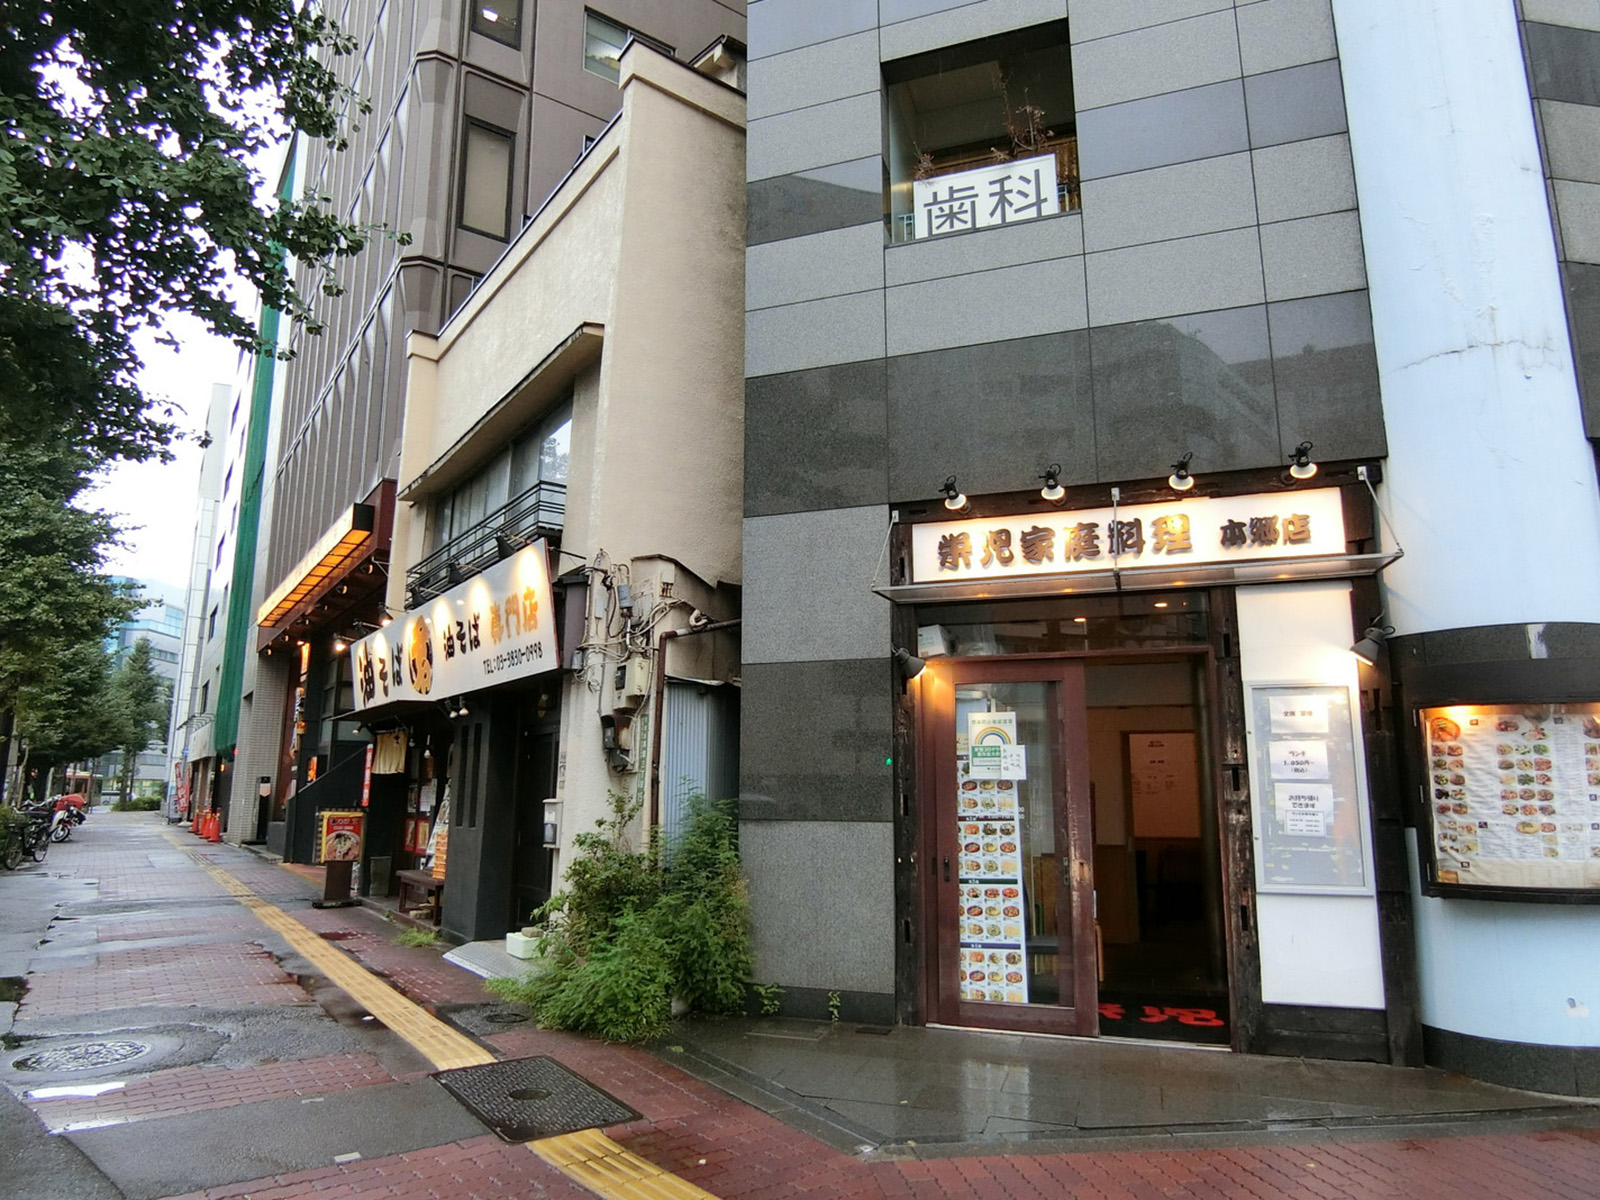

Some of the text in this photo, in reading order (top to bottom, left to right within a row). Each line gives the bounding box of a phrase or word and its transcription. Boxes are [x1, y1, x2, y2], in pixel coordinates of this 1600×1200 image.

[923, 168, 1048, 236] 歯科
[1220, 514, 1311, 546] 本郷店
[443, 612, 480, 661] 油そば
[483, 642, 543, 675] TEL:03-3830-0998
[359, 641, 403, 708] 油そば
